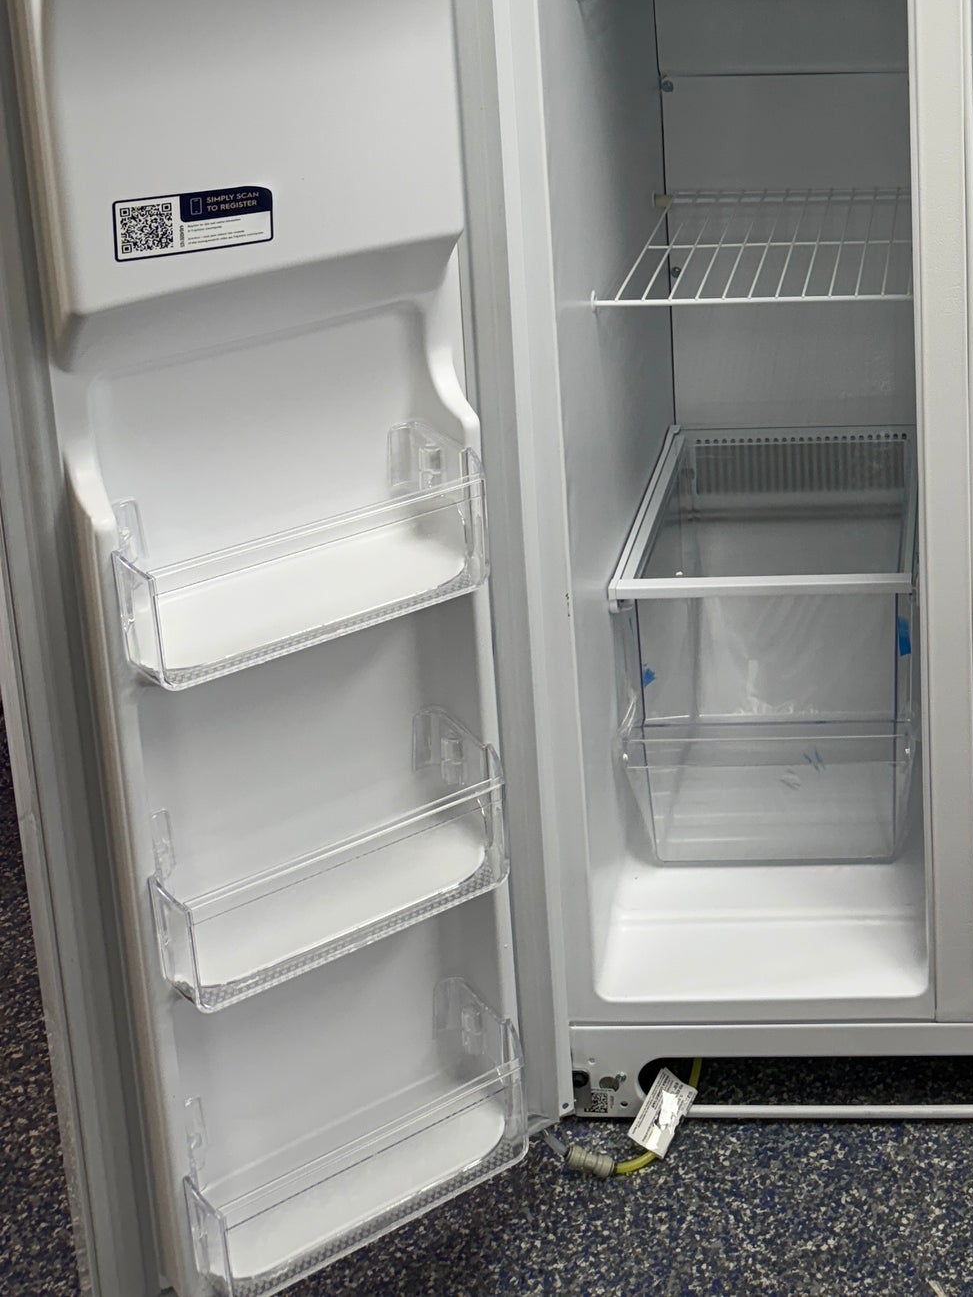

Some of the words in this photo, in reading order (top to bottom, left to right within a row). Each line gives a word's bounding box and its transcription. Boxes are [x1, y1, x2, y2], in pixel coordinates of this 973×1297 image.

[206, 194, 235, 204] SIMPLY
[236, 191, 260, 200] SCAN
[220, 200, 257, 210] REGISTER
